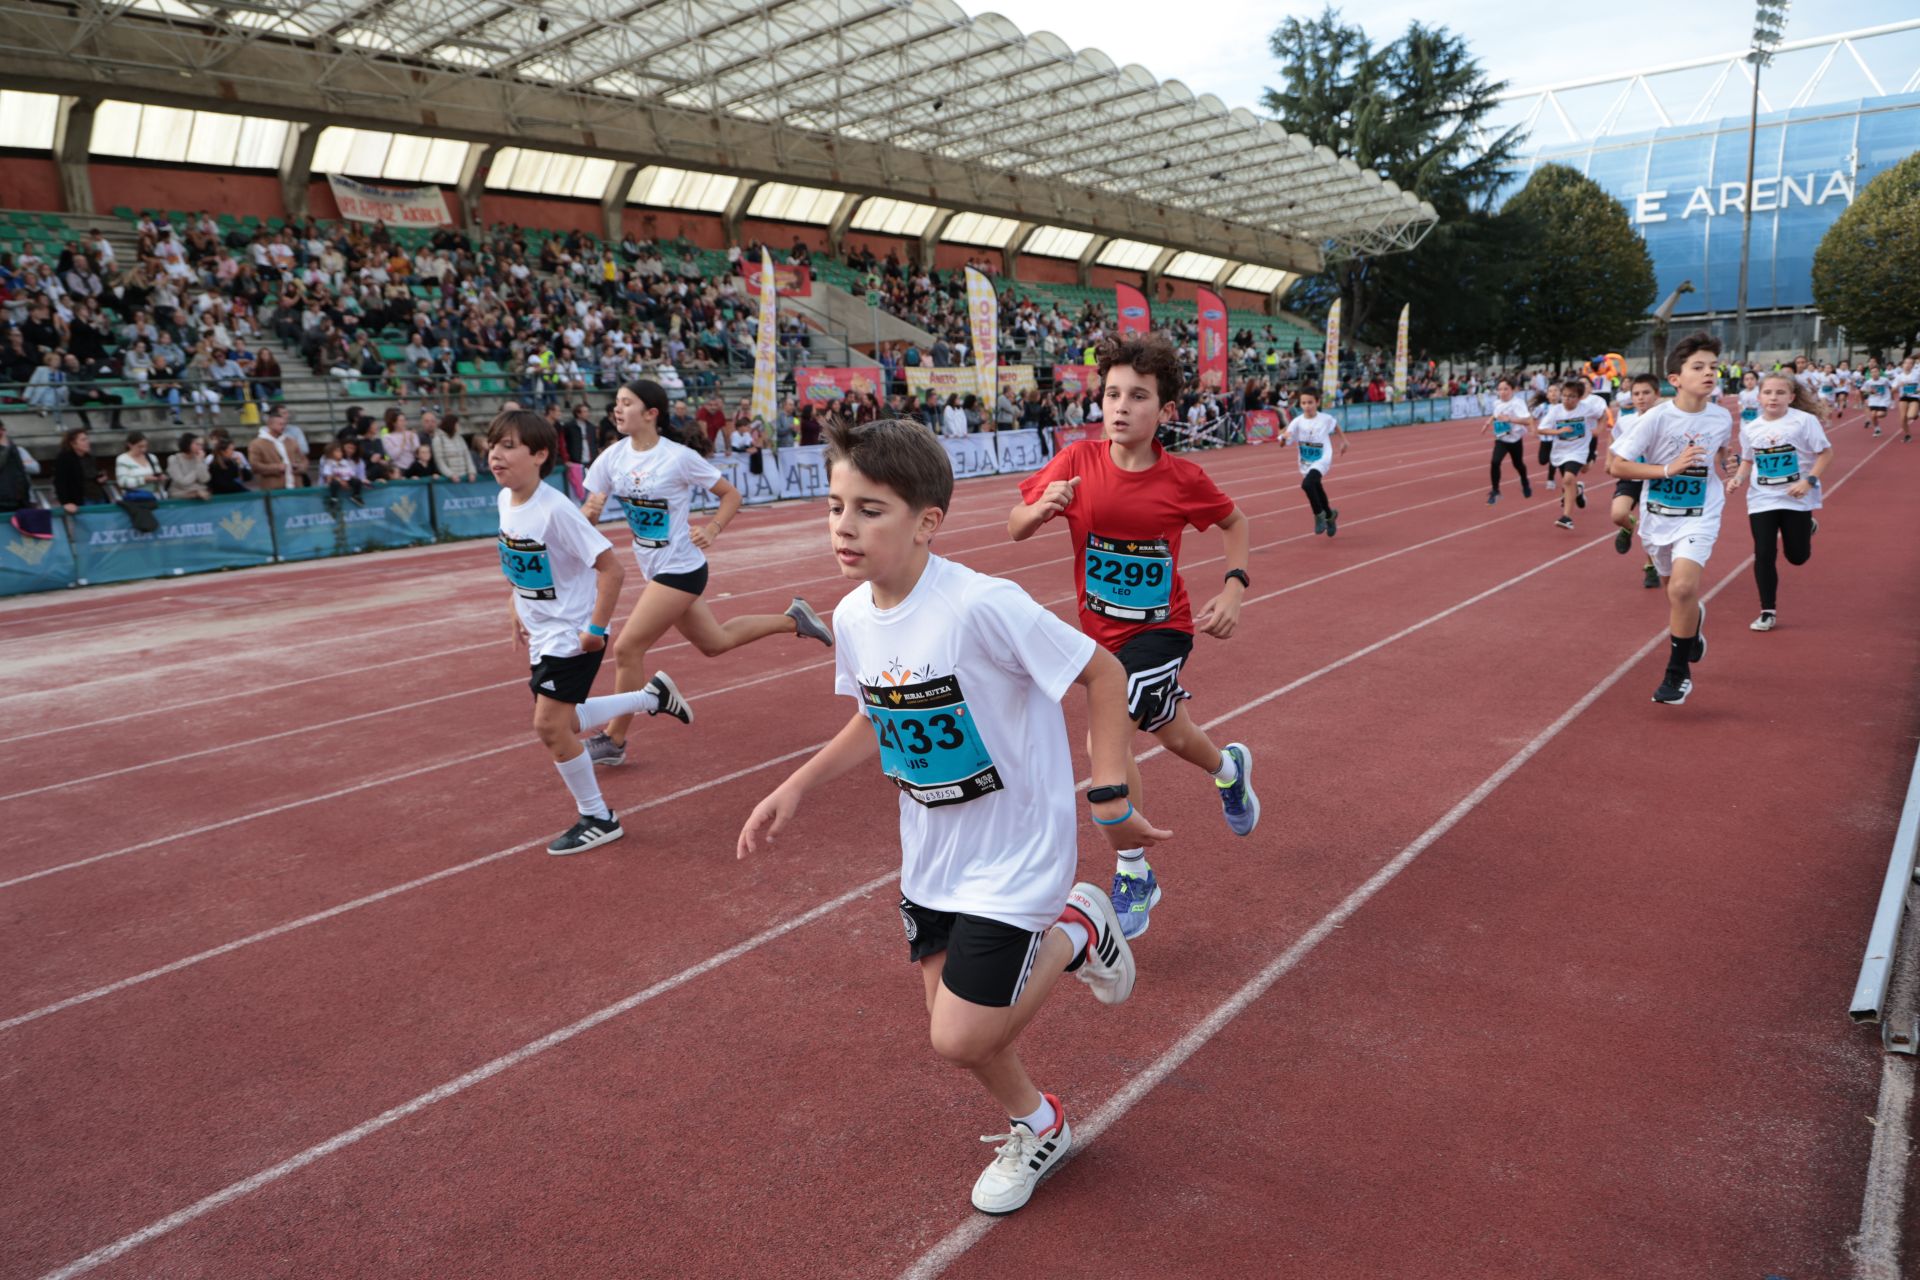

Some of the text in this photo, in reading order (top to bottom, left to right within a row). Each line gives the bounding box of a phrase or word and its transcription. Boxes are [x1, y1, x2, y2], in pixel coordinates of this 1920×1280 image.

[1681, 170, 1855, 220] ARENA
[1756, 455, 1793, 468] 2172
[1649, 478, 1701, 495] 2303
[1087, 554, 1163, 587] 2299
[1112, 587, 1131, 596] LEO
[903, 692, 925, 701] RURAL
[925, 685, 952, 698] KUTXA
[872, 713, 965, 755] 2133
